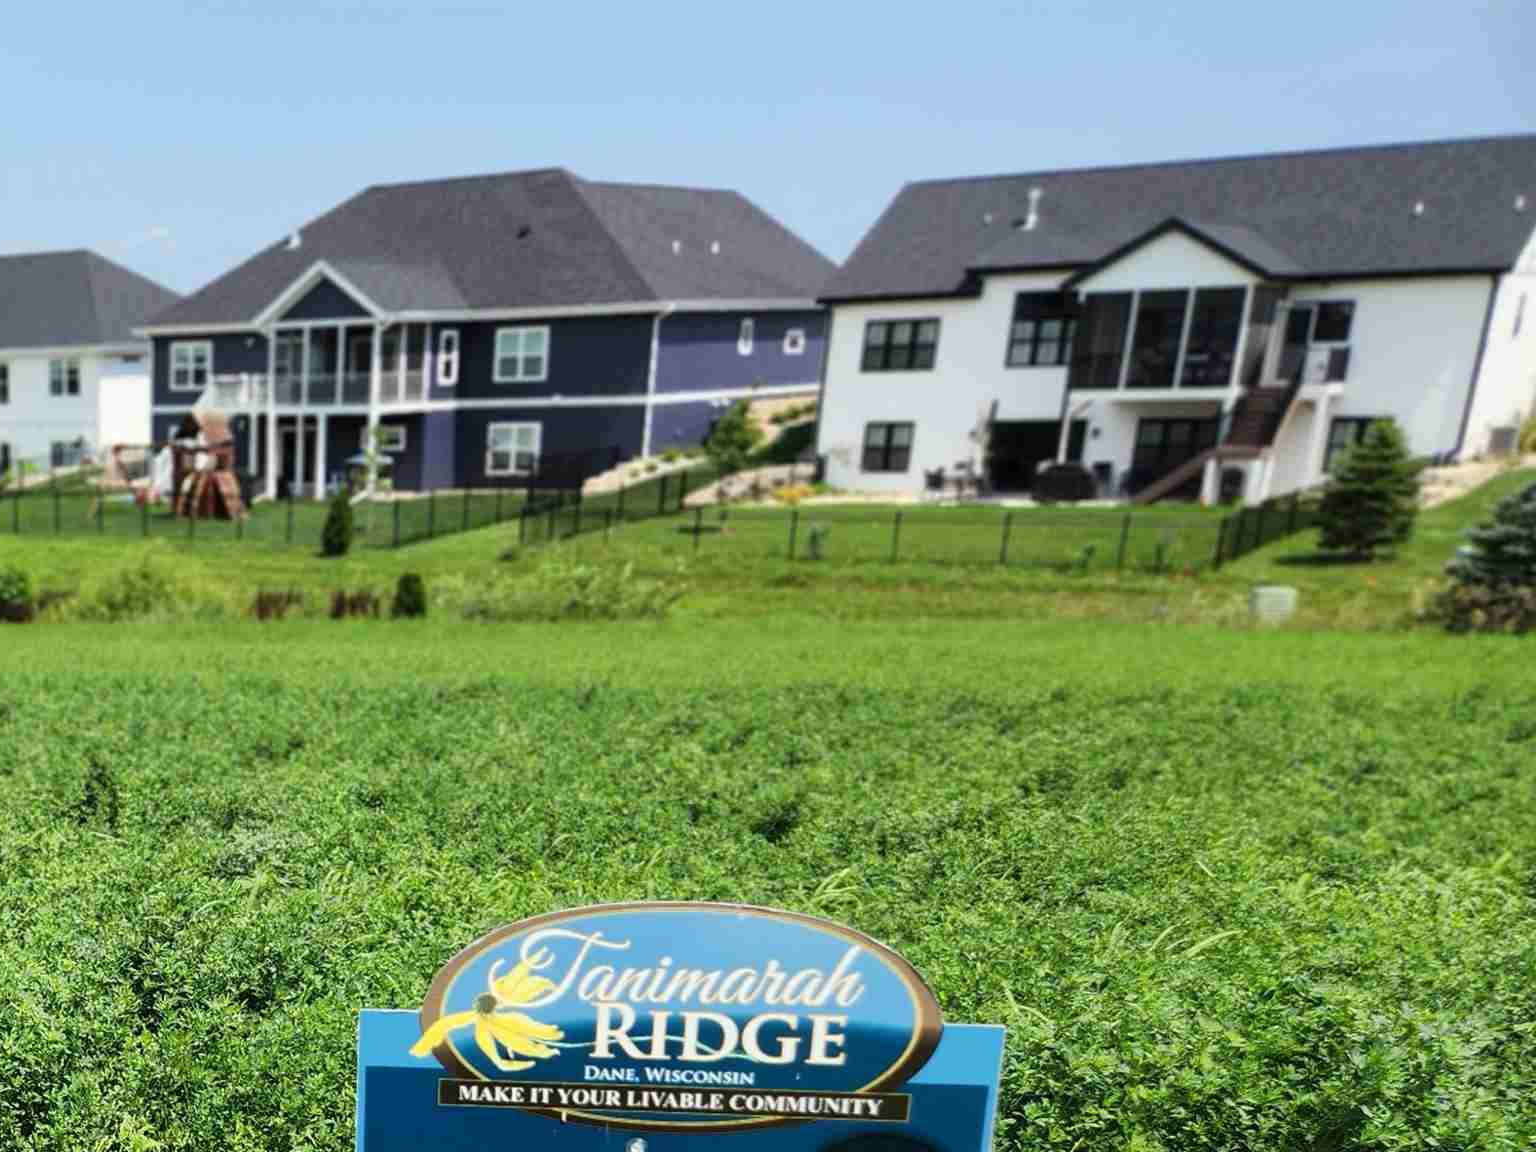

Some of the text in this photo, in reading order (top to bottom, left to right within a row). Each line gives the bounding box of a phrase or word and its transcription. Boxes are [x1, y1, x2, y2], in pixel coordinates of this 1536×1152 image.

[488, 927, 864, 1007] Tanimarah
[591, 1002, 848, 1066] RIDGE
[458, 1085, 883, 1116] MAKE IT YOUR LIVABLE COMMUNITY
